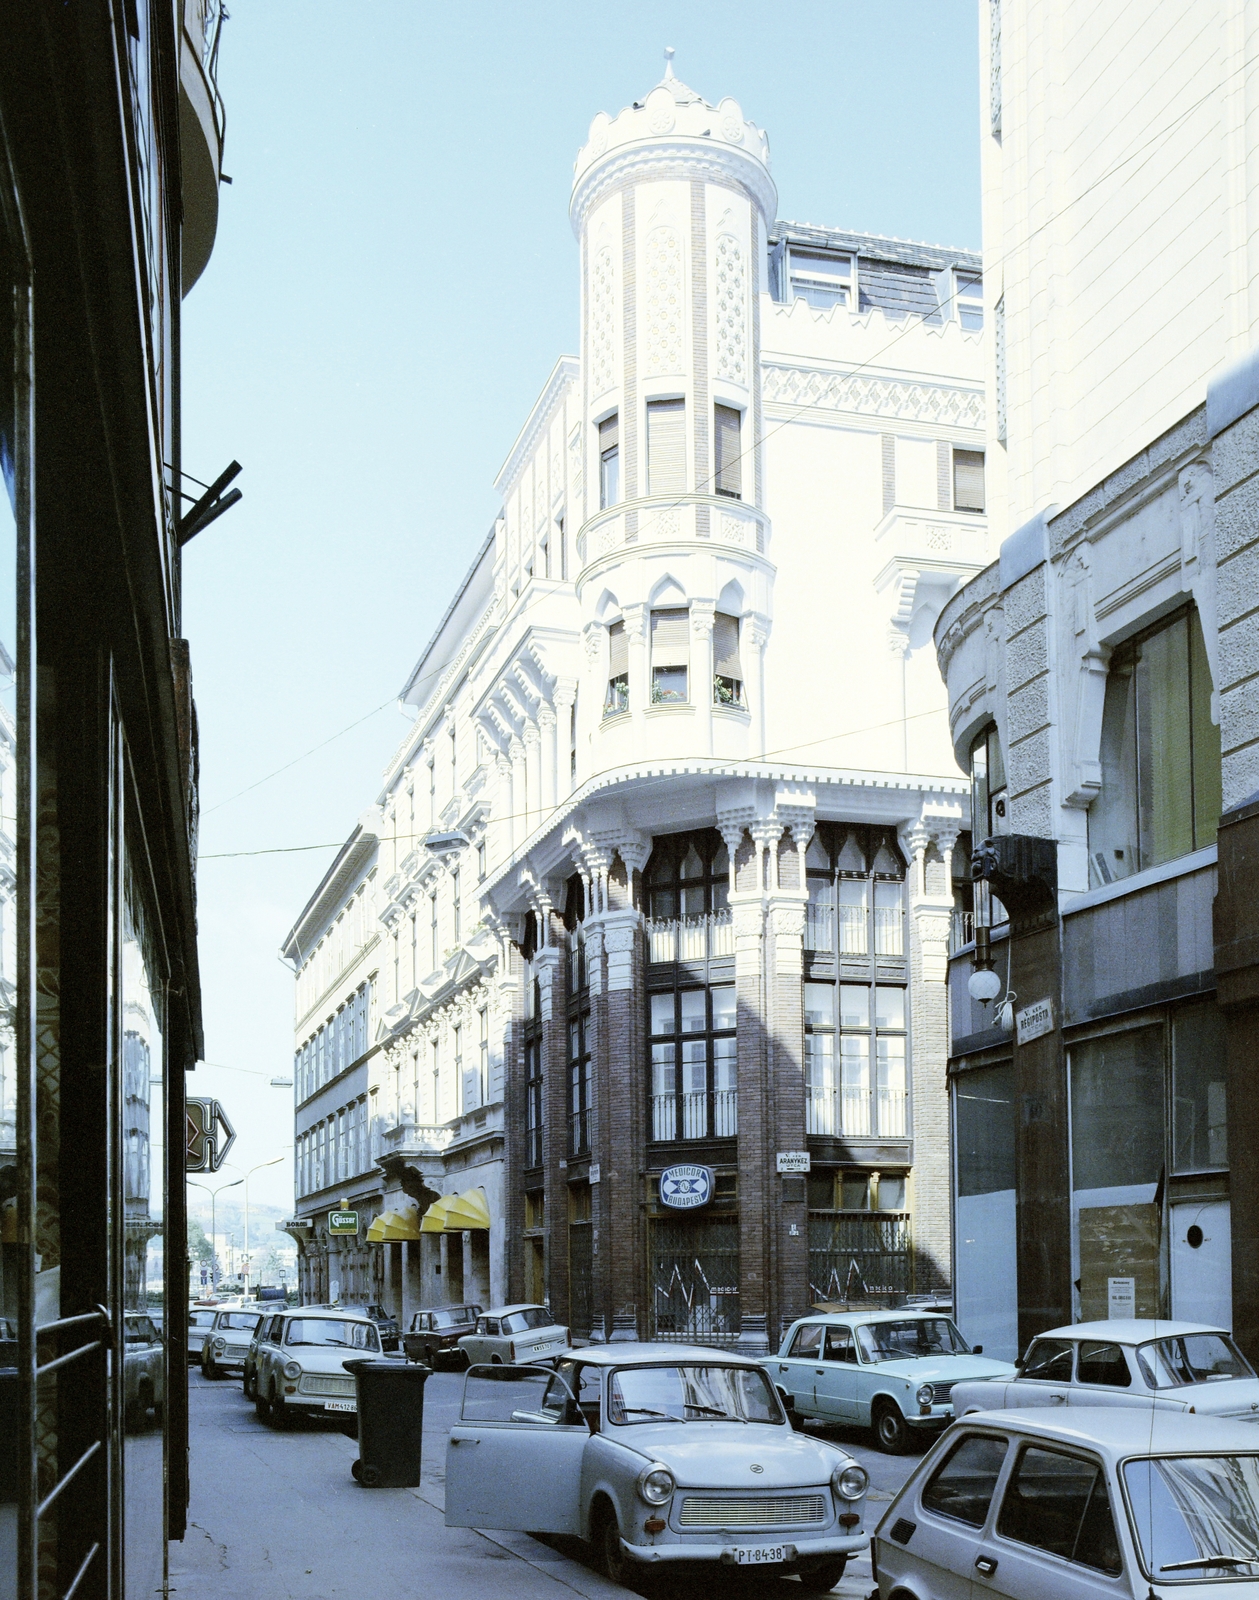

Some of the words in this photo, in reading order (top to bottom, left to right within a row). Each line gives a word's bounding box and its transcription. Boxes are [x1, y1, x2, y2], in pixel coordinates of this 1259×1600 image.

[1020, 1008, 1049, 1031] RÉGIPOSTA
[779, 1157, 808, 1165] ARANYKÉZ
[668, 1166, 701, 1178] MEDICOR
[667, 1193, 702, 1206] BUDAPEST
[331, 1213, 356, 1228] Gösser
